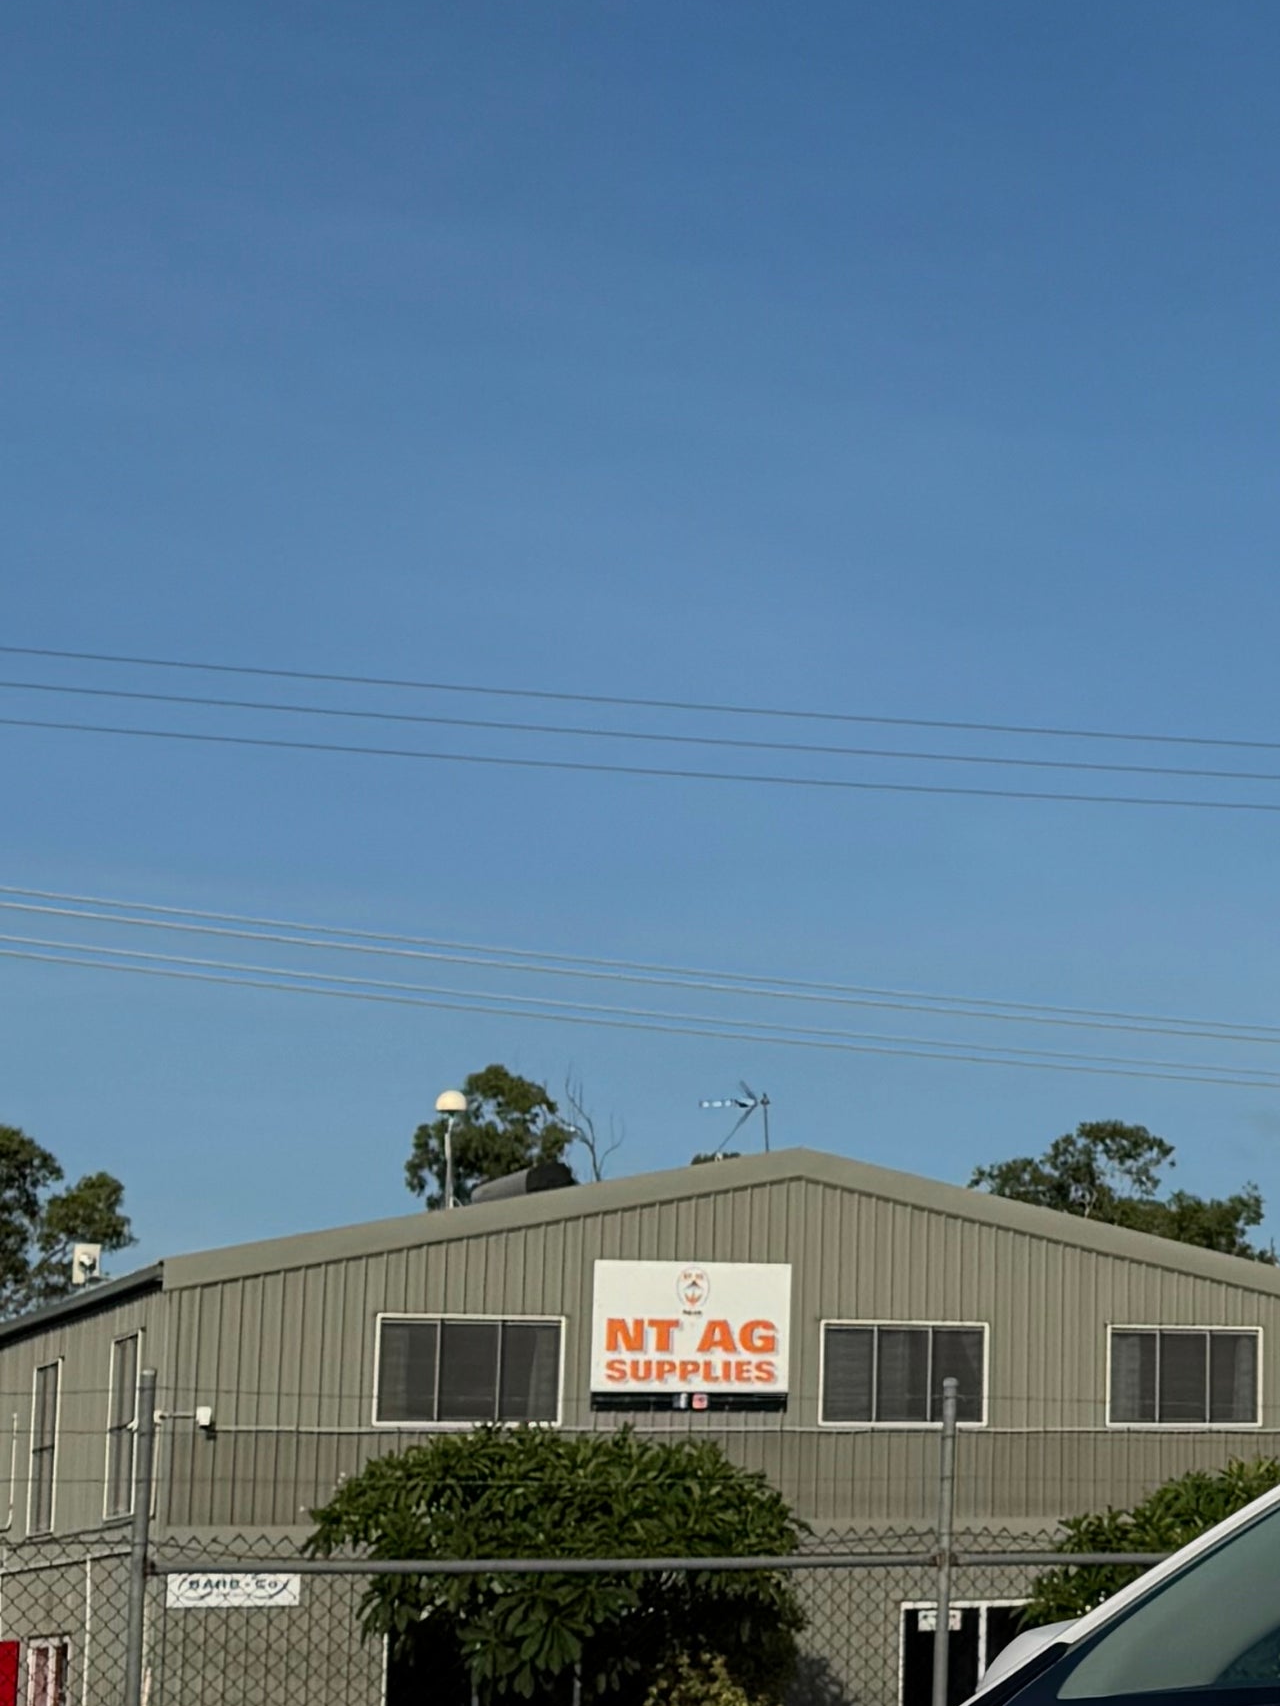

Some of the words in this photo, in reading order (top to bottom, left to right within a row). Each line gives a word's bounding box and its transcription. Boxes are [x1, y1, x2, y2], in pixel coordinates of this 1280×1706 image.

[605, 1317, 680, 1352] NT
[696, 1319, 778, 1354] AG
[604, 1359, 777, 1383] SUPPLIES
